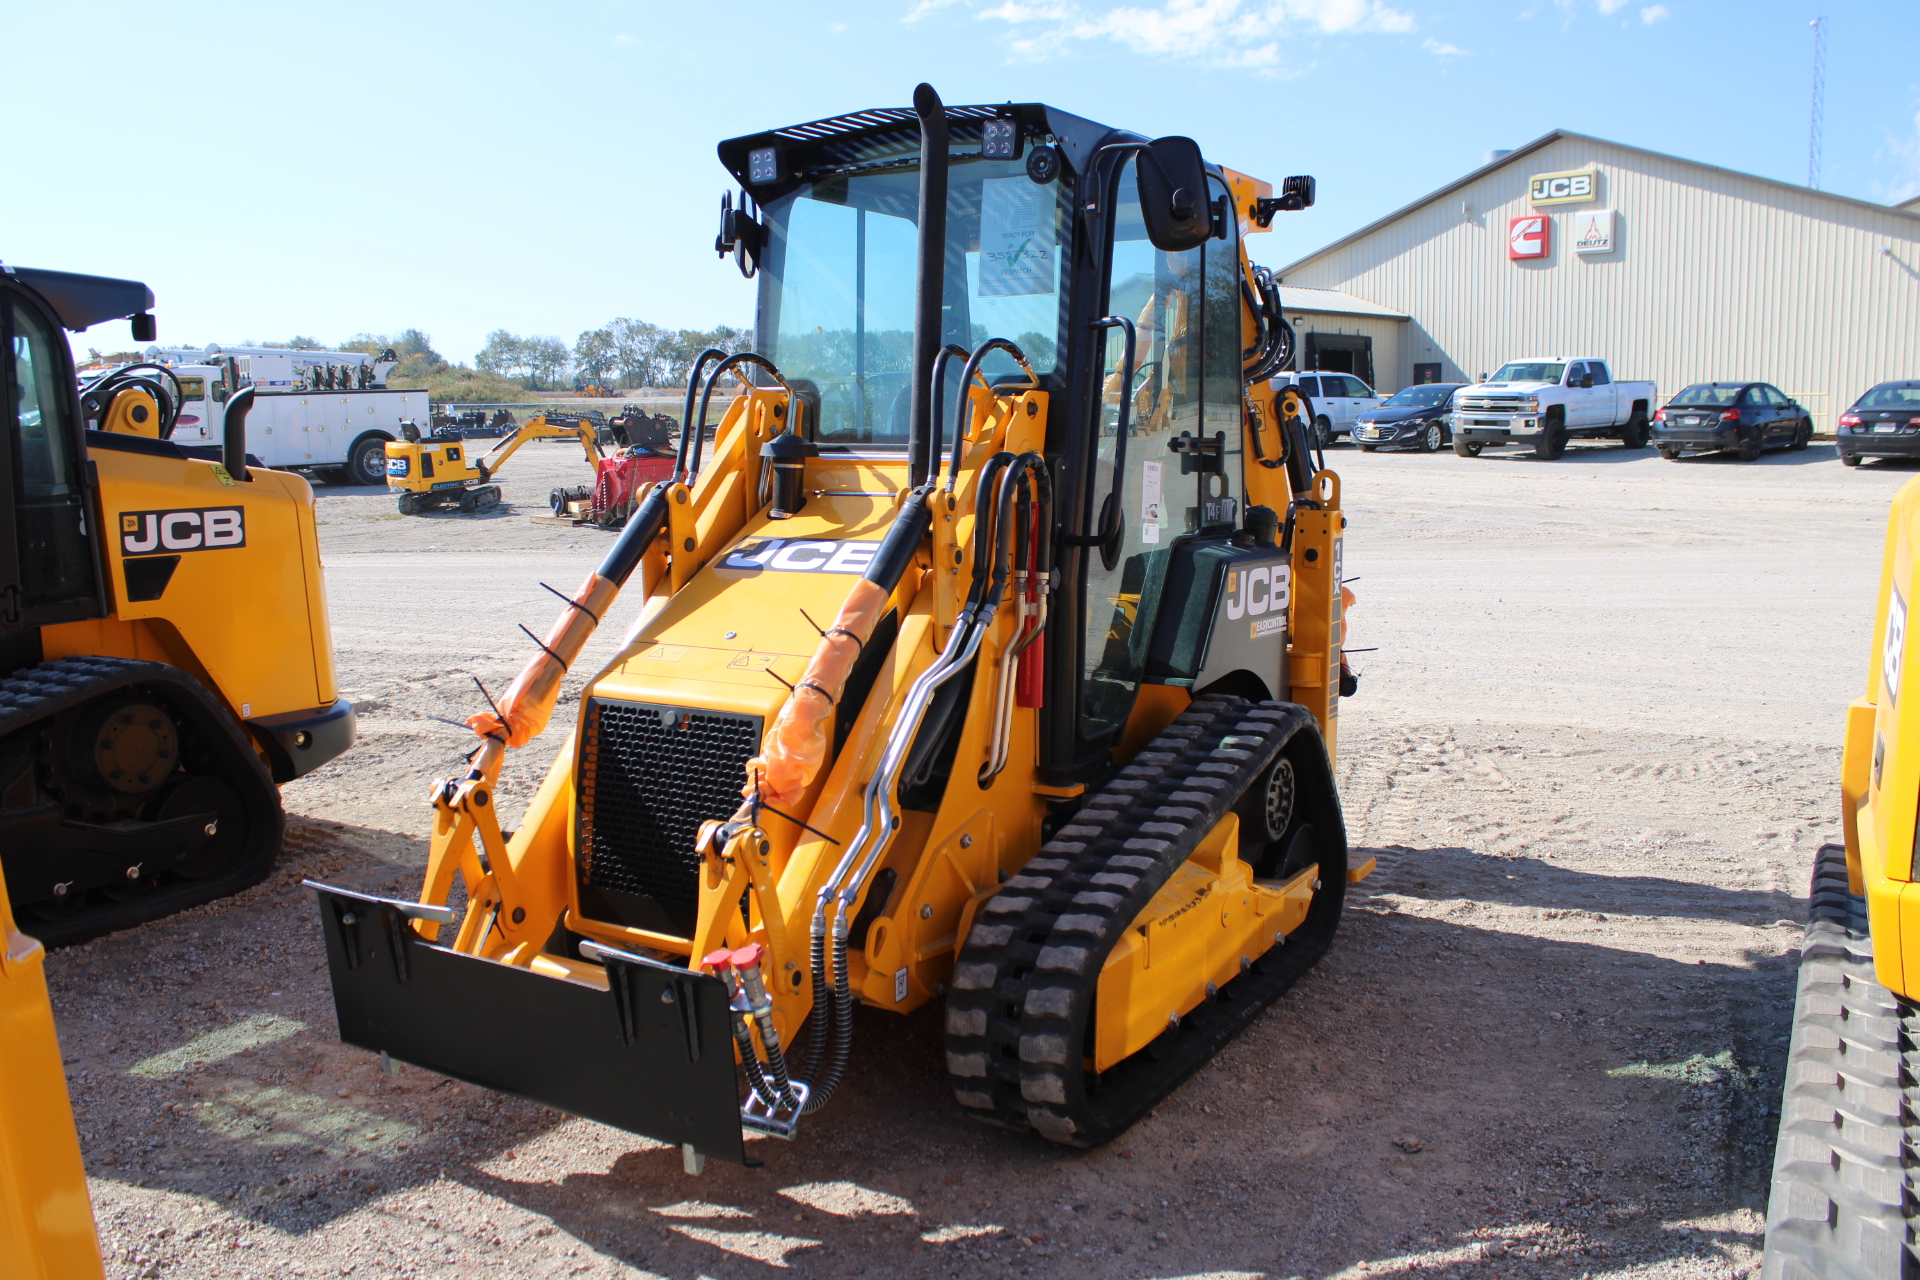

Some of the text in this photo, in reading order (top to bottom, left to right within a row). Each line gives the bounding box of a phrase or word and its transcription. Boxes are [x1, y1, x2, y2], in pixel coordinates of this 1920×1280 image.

[1533, 176, 1590, 199] JCB
[1577, 239, 1609, 247] DEUTZ
[1001, 267, 1032, 276] DESPATCH
[124, 510, 243, 552] JCB
[1333, 541, 1341, 595] 1CX
[1227, 564, 1290, 620] JCB
[1257, 615, 1287, 633] EASYCONTROL
[1884, 591, 1905, 696] CB
